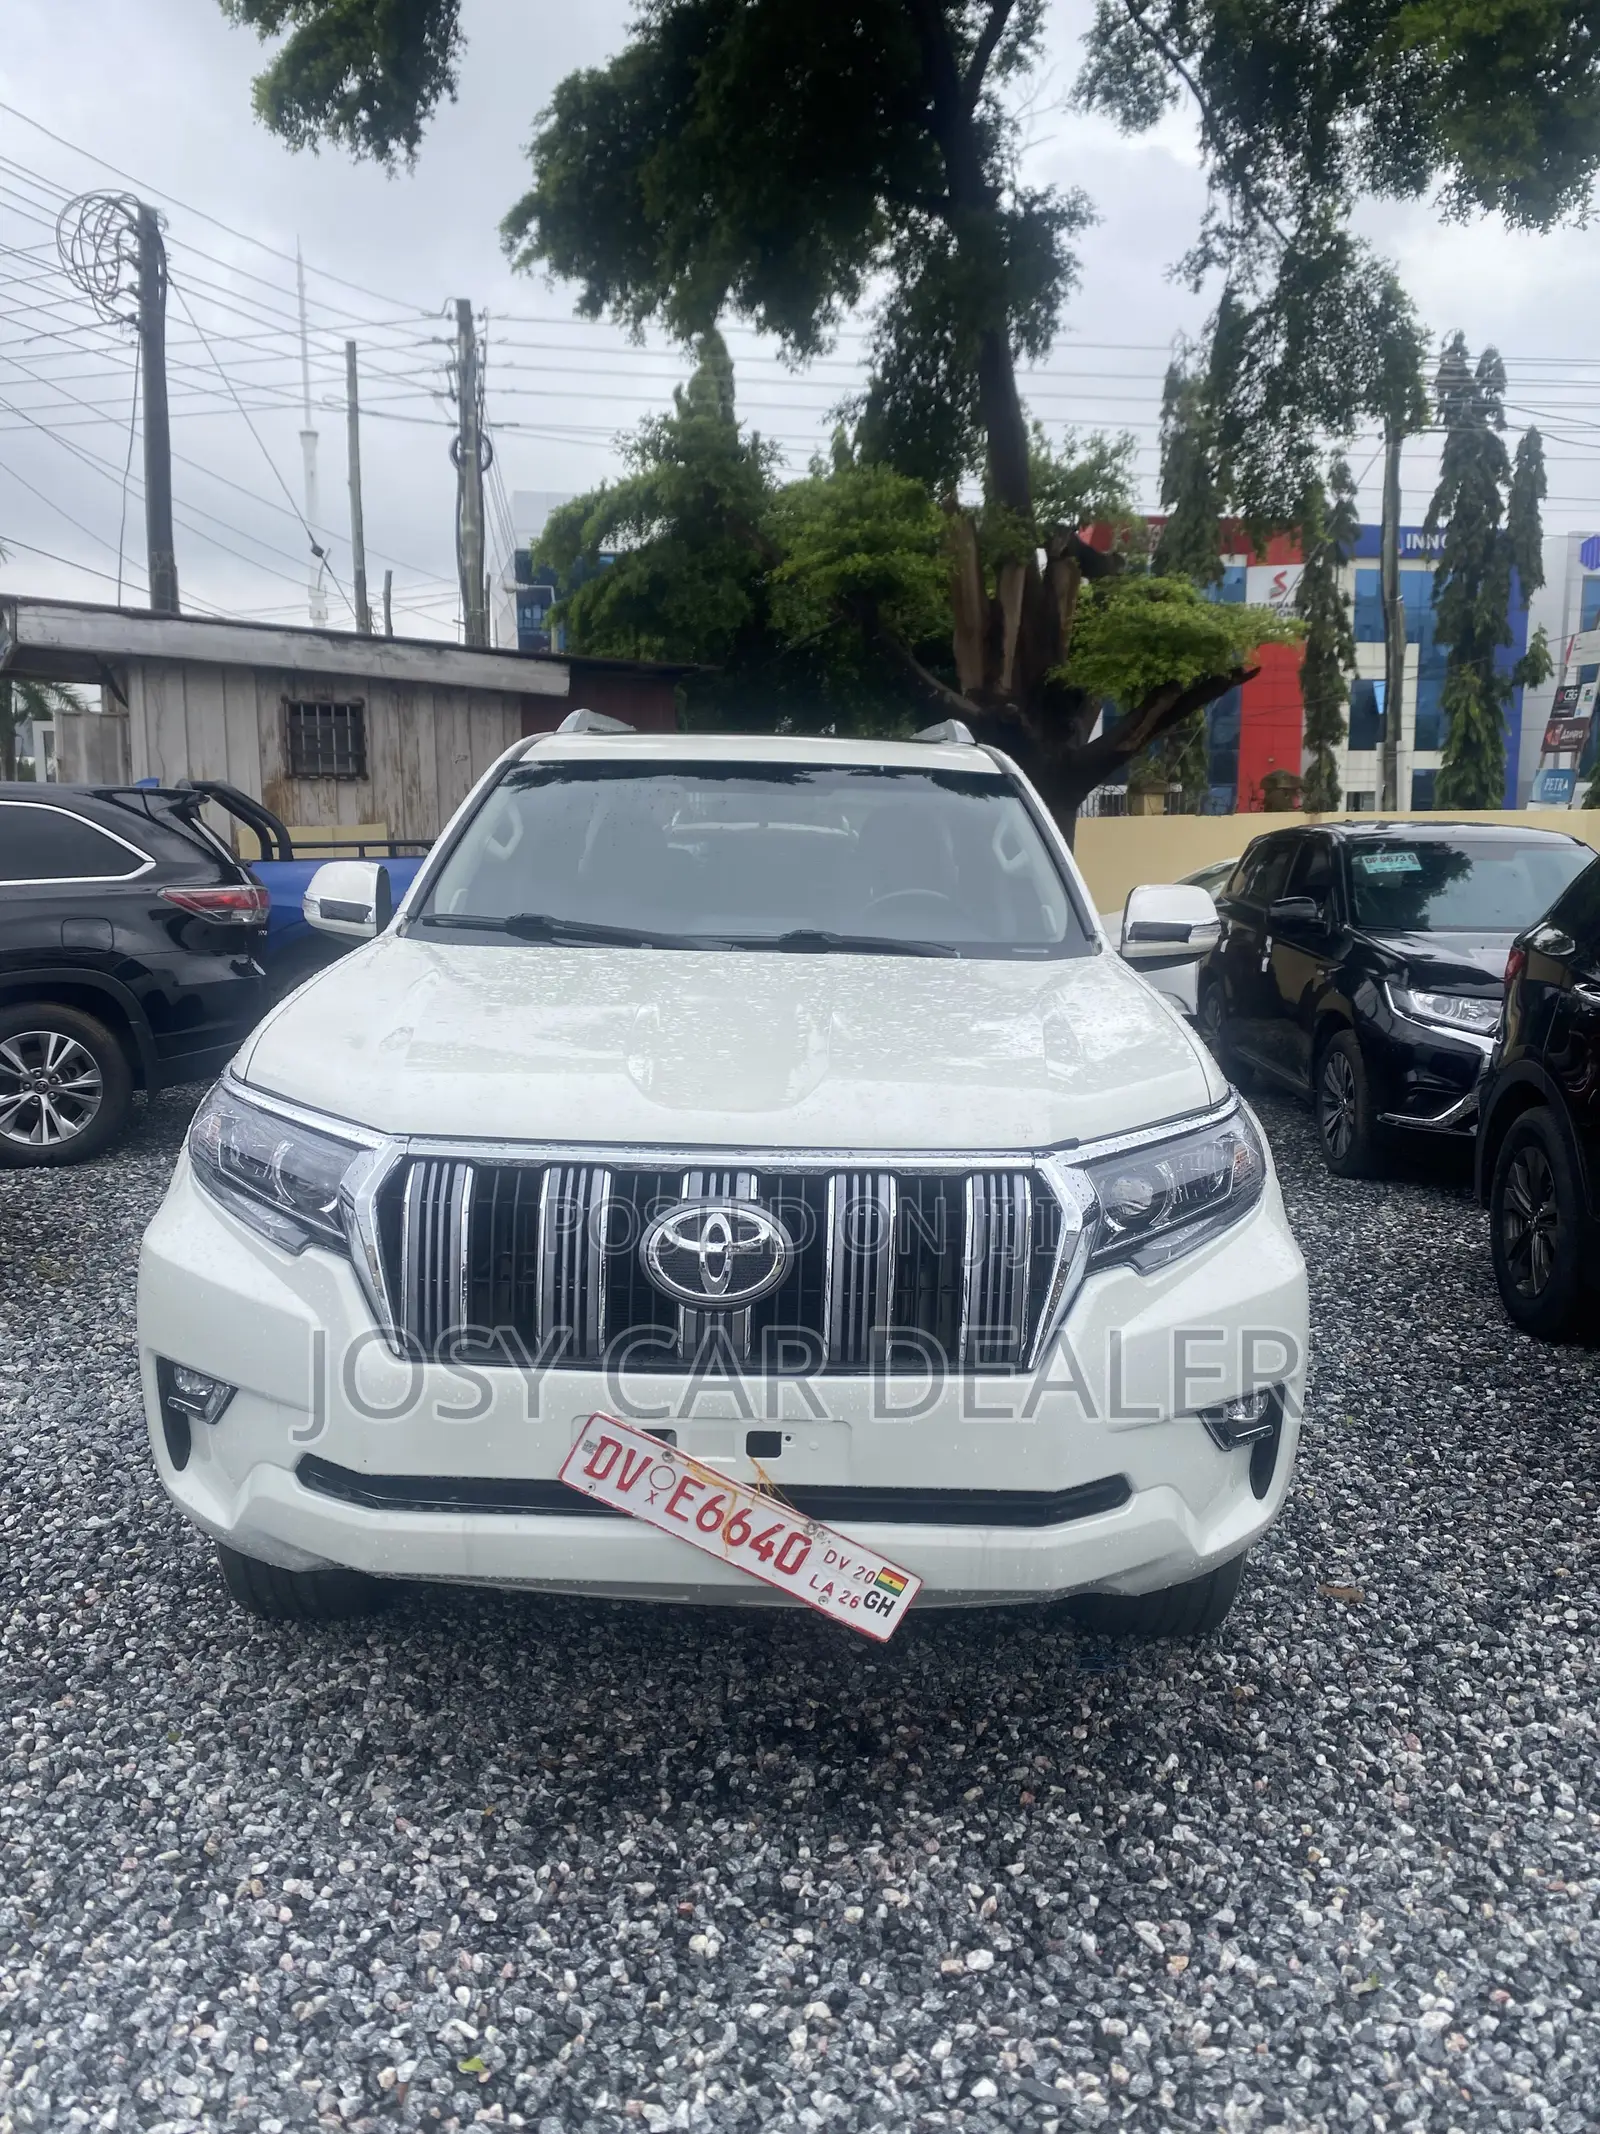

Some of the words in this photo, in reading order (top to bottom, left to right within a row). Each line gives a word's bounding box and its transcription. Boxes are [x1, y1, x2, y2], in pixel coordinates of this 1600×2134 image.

[1544, 778, 1569, 791] PETRA
[583, 1435, 653, 1492] DV
[664, 1475, 813, 1576] E6640
[824, 1549, 851, 1570] DV
[853, 1566, 876, 1584] 20
[809, 1574, 834, 1597] LA
[838, 1590, 861, 1609] 26
[864, 1590, 896, 1618] GH
